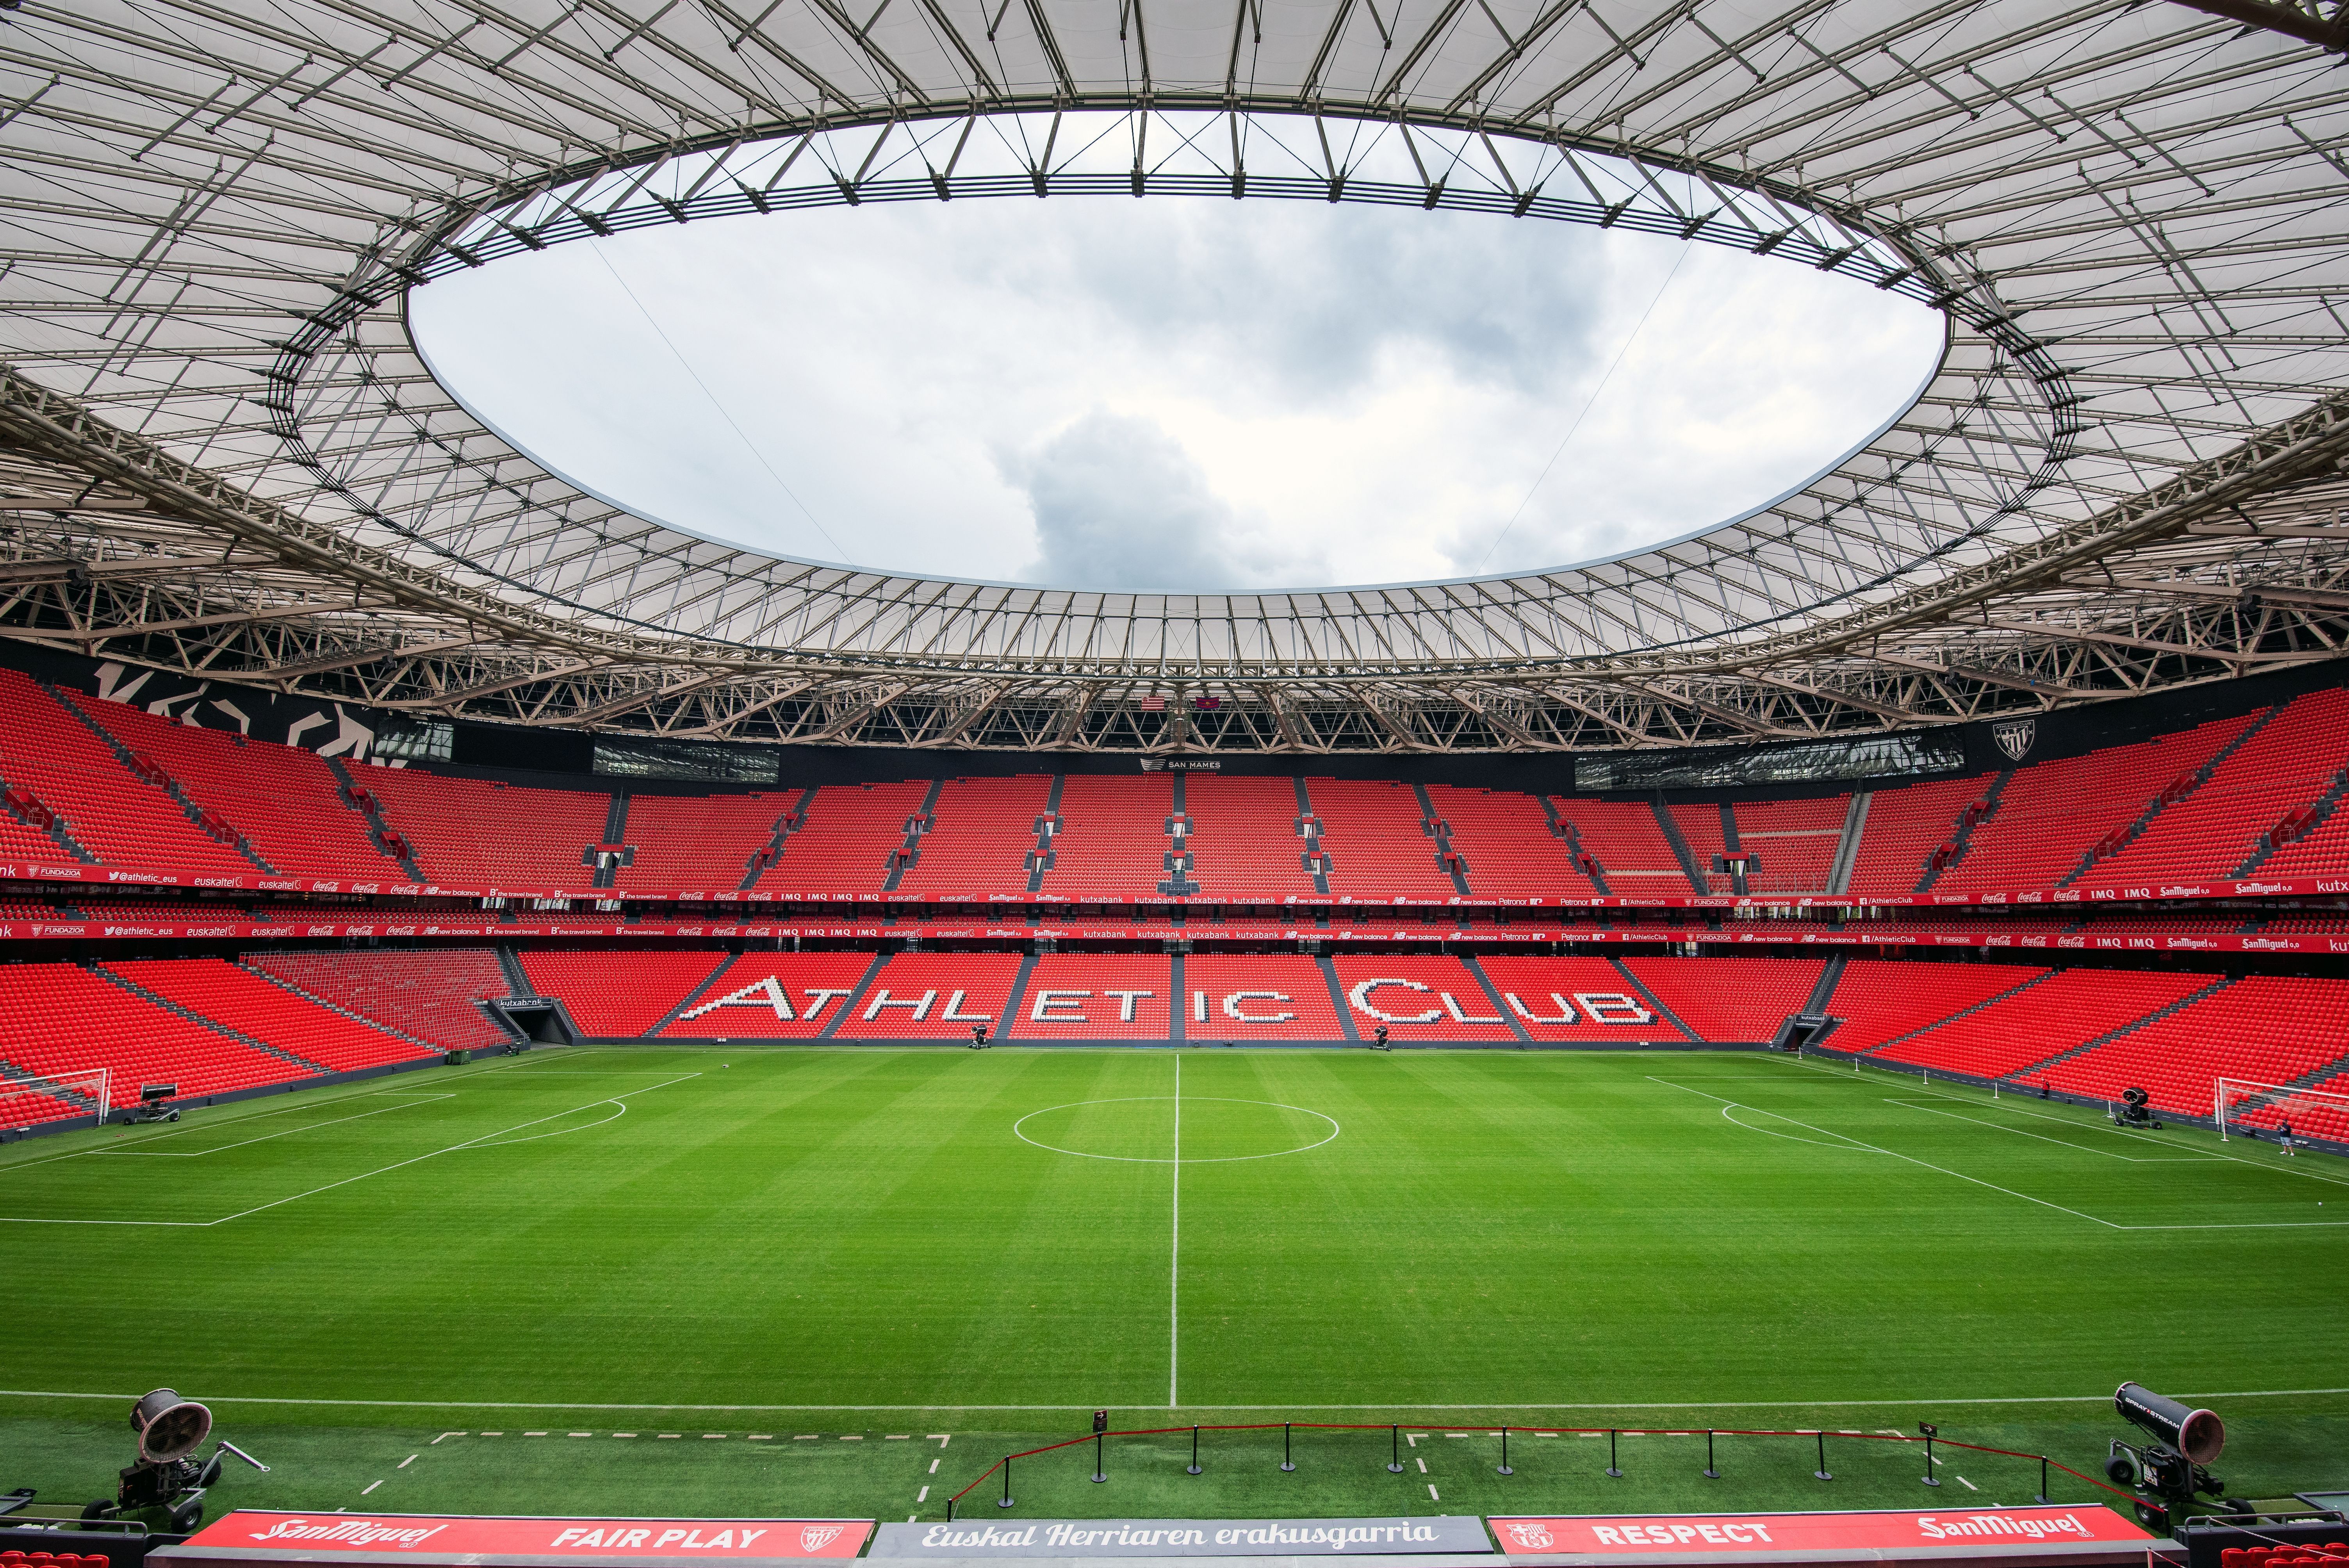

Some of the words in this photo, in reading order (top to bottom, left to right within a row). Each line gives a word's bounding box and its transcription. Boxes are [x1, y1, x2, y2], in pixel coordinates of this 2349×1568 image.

[2008, 747, 2025, 759] BILBAO
[119, 873, 177, 883] @athletic_eus
[195, 878, 234, 887] euskaltel
[258, 881, 294, 889] euskaltel
[313, 881, 340, 891] Coca-Cola
[352, 883, 380, 893] Coca-Cola
[391, 885, 421, 894] Coca-Cola
[679, 892, 705, 900] Coca-Cola
[714, 892, 739, 900] Coca-Cola
[2018, 892, 2042, 902] Coca-Cola
[2054, 890, 2080, 901] Coca-Cola
[2091, 890, 2116, 899] IMQ
[2124, 888, 2151, 898] IMQ
[1135, 896, 1177, 904] kutxabank
[1185, 896, 1227, 904] kutxabank
[1982, 893, 2007, 903] Coca-Cola
[115, 927, 173, 935] @athletic_eus
[187, 927, 227, 936] euskaltel
[252, 927, 287, 935] euskaltel
[308, 926, 335, 936] Coca-Cola
[346, 926, 374, 935] Coca-Cola
[387, 926, 417, 935] Coca-Cola
[677, 927, 703, 935] Coca-Cola
[713, 927, 737, 935] Coca-Cola
[746, 928, 771, 936] Coca-Cola
[885, 929, 916, 937] euskaltel
[1986, 936, 2010, 945] Coca-Cola
[2022, 936, 2046, 946] Coca-Cola
[2058, 937, 2085, 947] Coca-Cola
[2097, 938, 2122, 948] IMQ
[2129, 938, 2155, 948] IMQ
[679, 975, 1298, 1023] ATHLETIC
[1349, 978, 1659, 1026] CLUB
[2125, 1397, 2148, 1411] SPRAY
[2150, 1411, 2180, 1429] STREAM
[550, 1529, 651, 1547] FAIR
[653, 1529, 768, 1548] PLAY
[922, 1525, 1038, 1547] Euskal
[1046, 1523, 1208, 1546] Herriaren
[1215, 1521, 1440, 1550] erakusgarria
[1592, 1524, 1773, 1544] RESPECT
